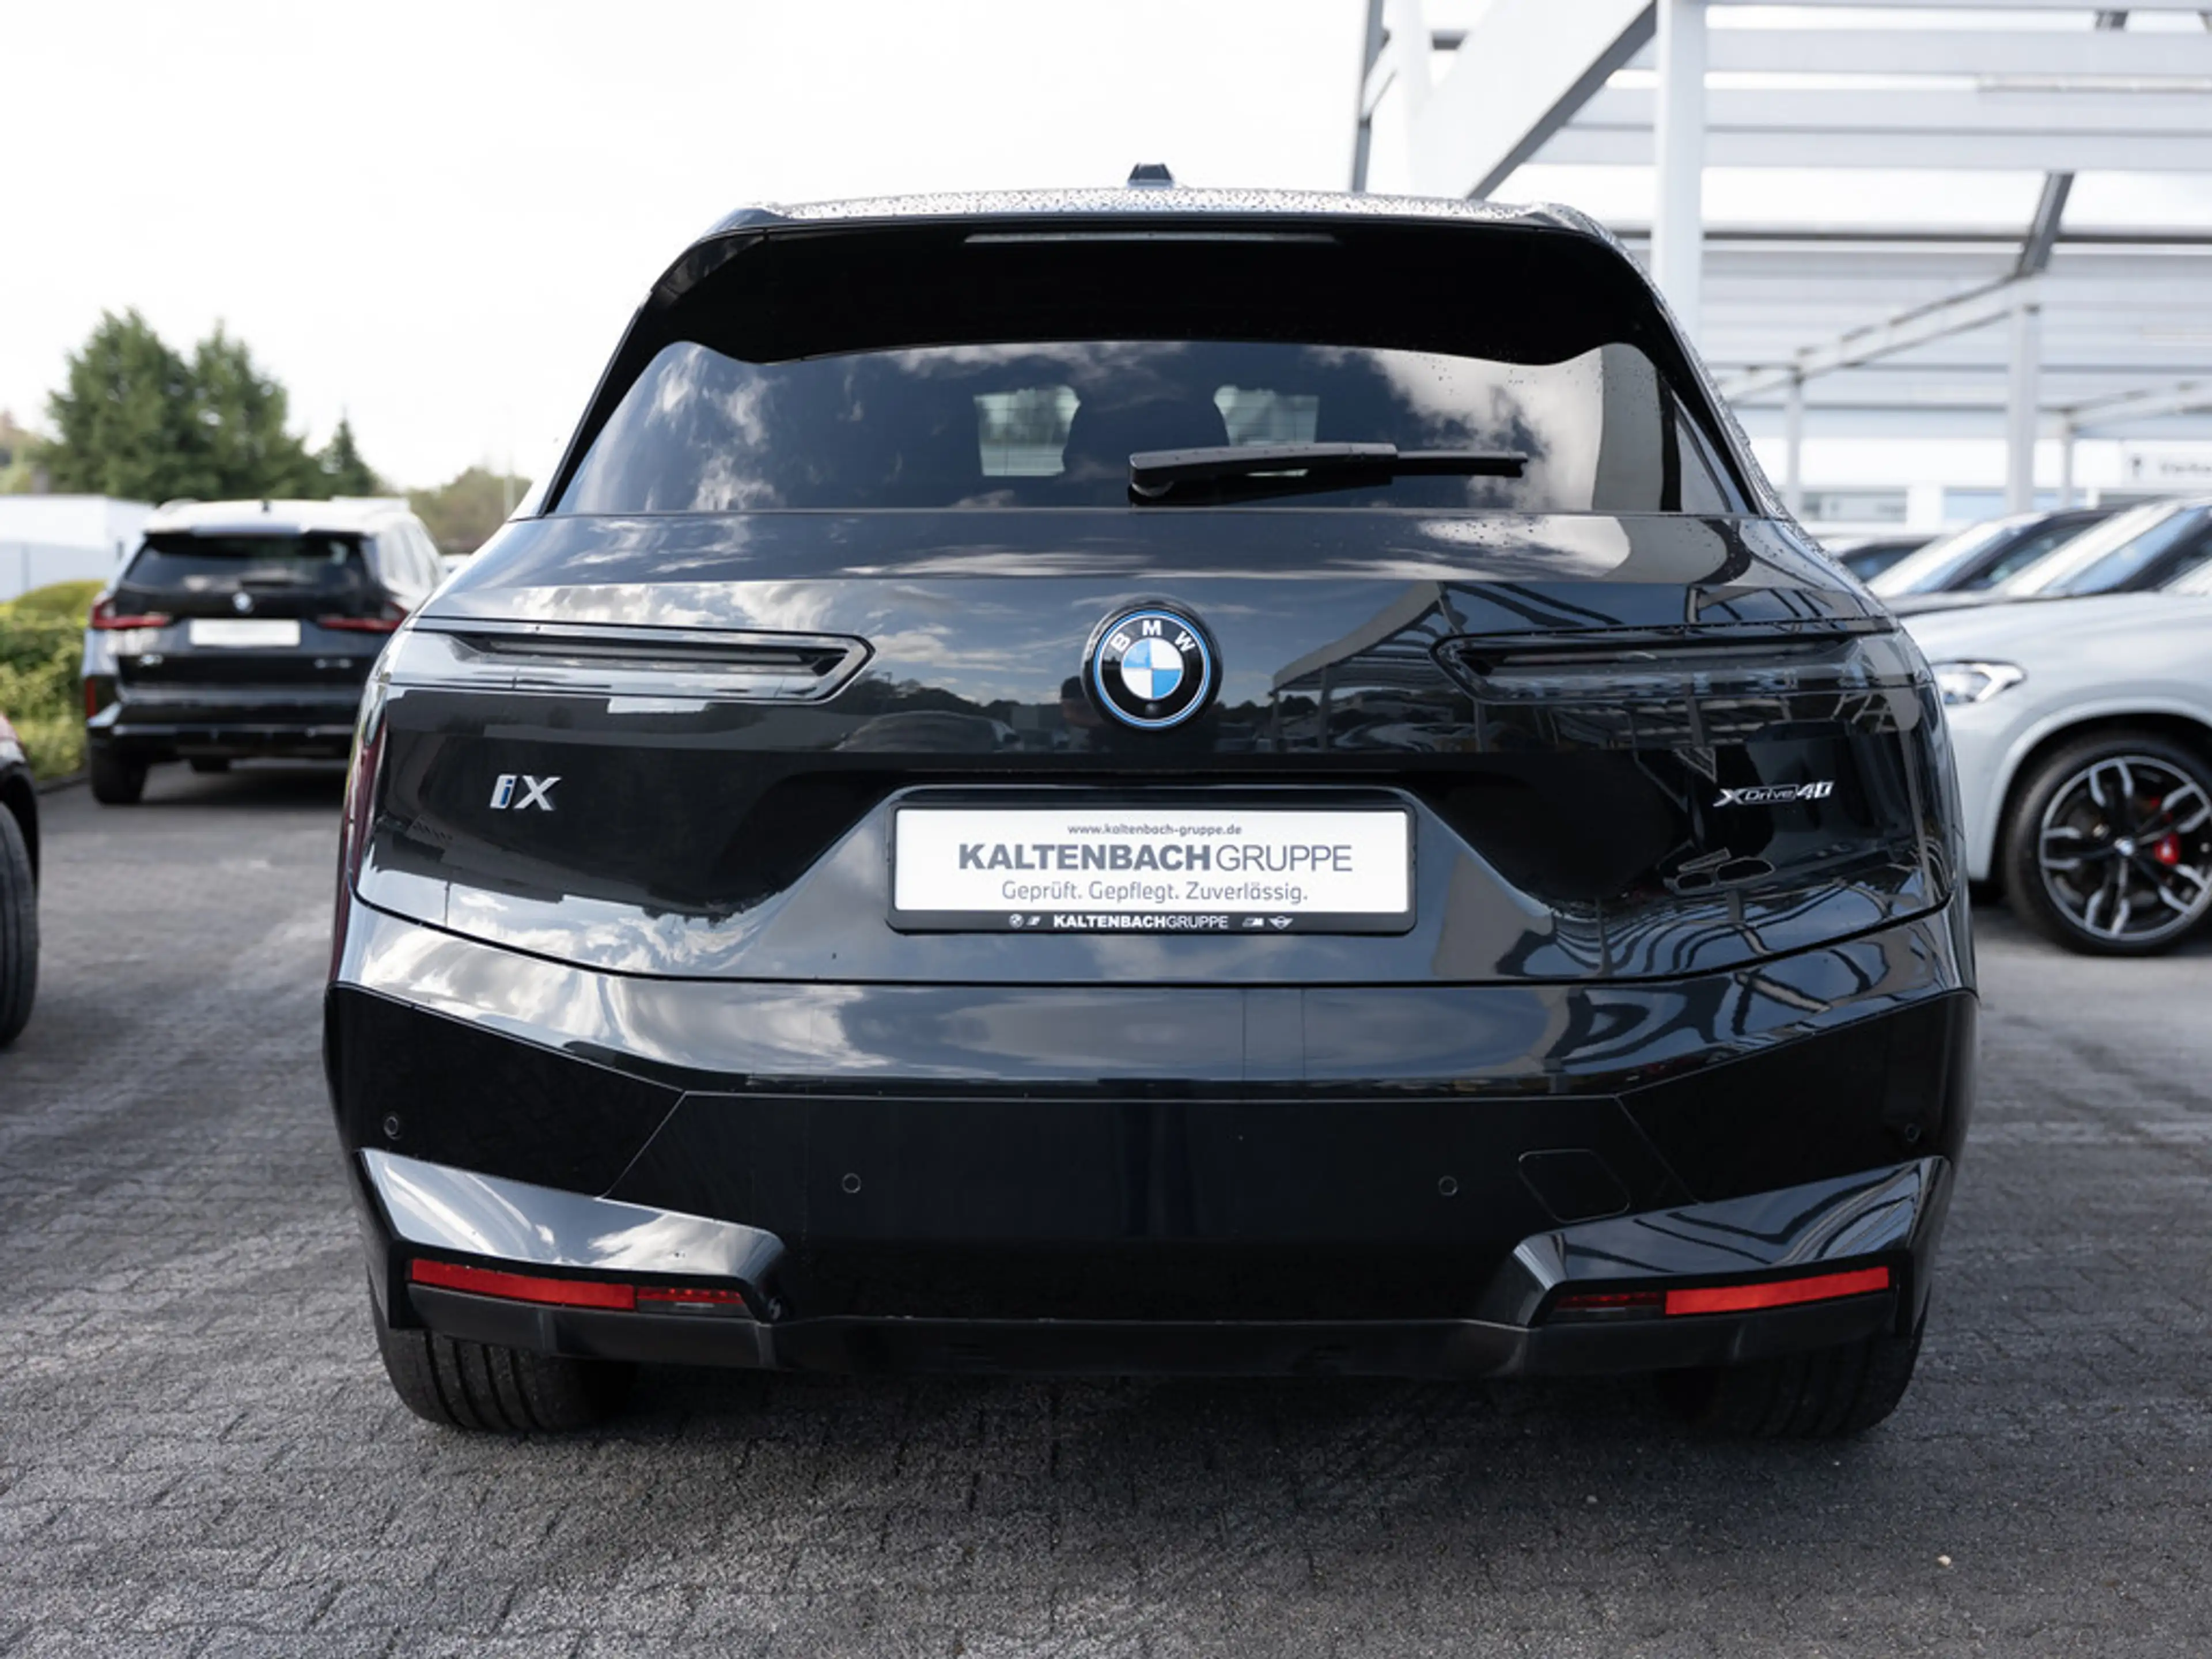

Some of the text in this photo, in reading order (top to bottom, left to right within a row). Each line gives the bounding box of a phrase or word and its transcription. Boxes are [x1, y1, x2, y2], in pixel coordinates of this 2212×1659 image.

[1110, 620, 1195, 652] BMW
[490, 774, 562, 810] iX
[1067, 824, 1242, 836] www.kaltenbach-gruppe.de
[1002, 880, 1308, 904] Geprüft. Gepflegt. Zuverlässig.
